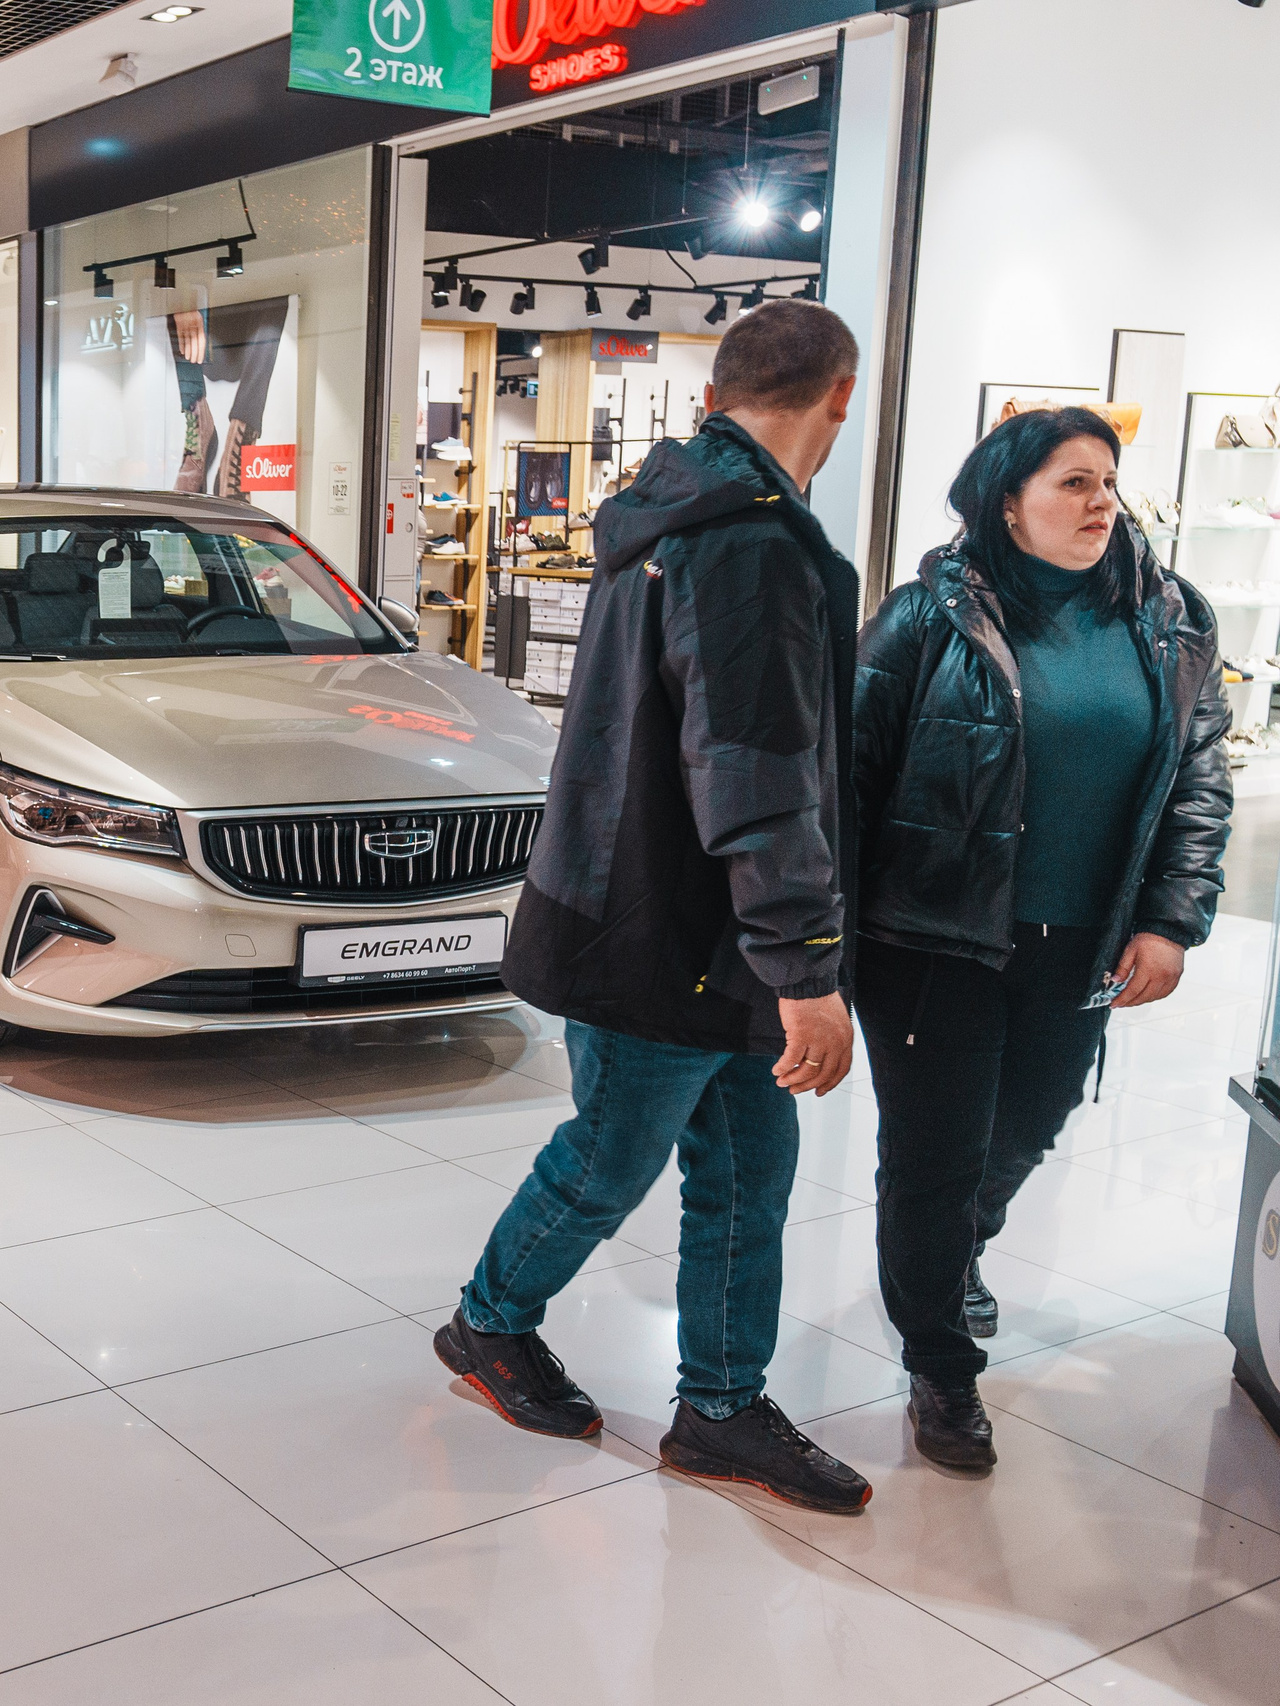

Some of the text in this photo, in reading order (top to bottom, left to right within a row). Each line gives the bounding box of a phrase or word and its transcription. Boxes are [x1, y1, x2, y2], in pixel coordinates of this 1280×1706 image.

[344, 46, 444, 89] 2 этаж
[530, 43, 628, 91] SHOES
[245, 457, 293, 479] s.Oliver
[341, 934, 471, 959] EMGRAND
